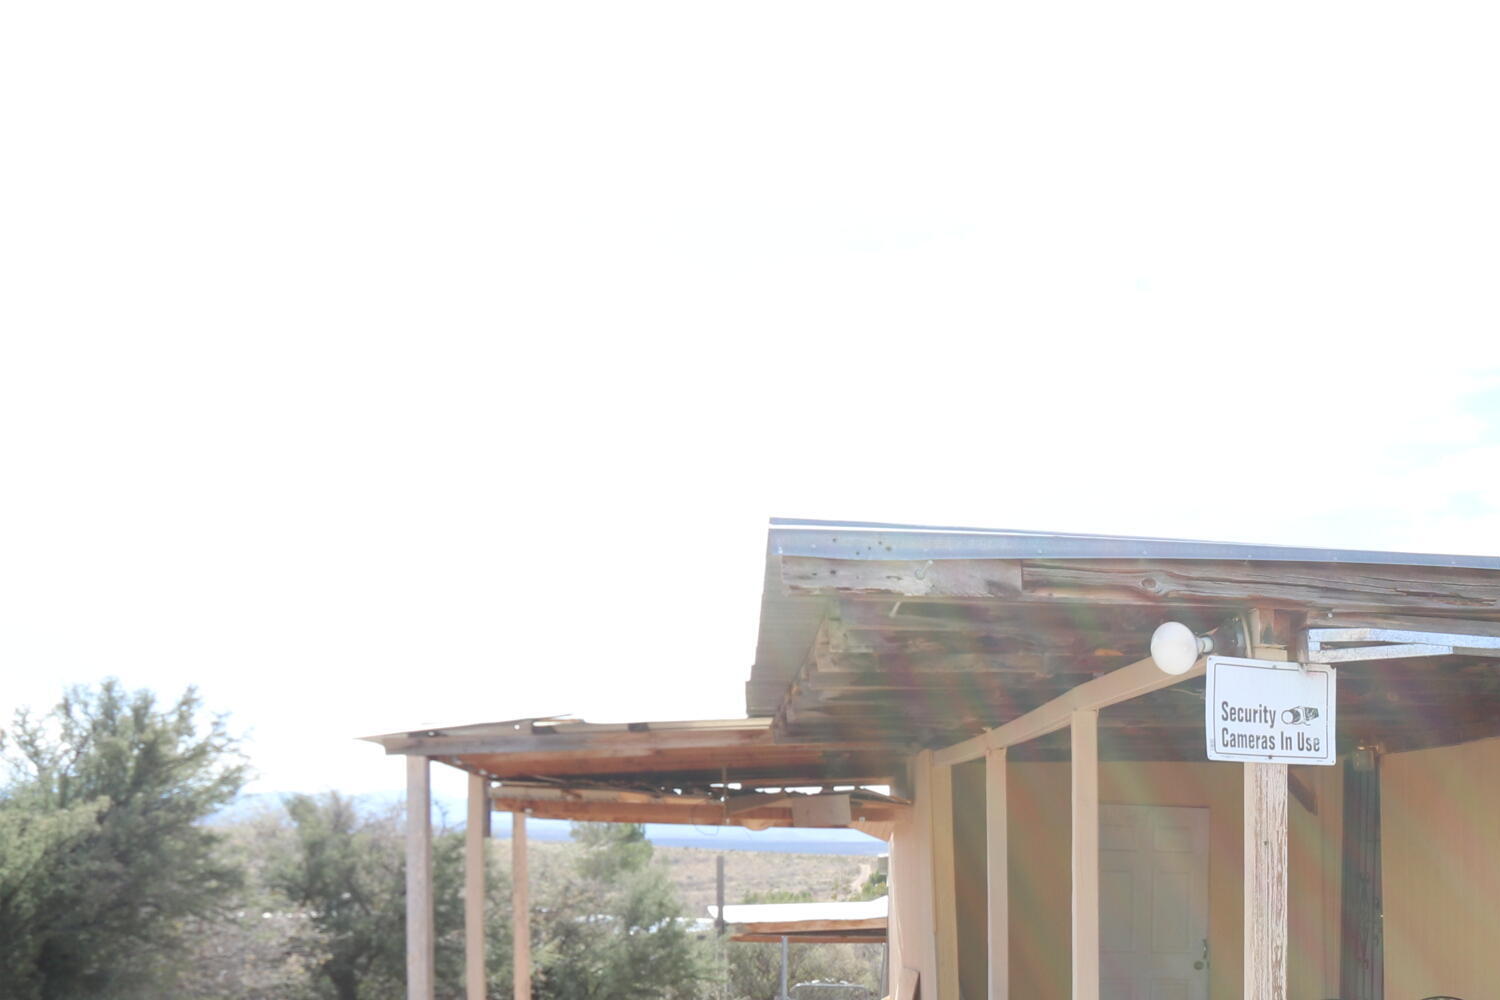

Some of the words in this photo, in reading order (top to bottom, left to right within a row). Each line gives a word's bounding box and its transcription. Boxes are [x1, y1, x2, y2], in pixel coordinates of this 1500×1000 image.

[1221, 700, 1276, 728] Security
[1221, 727, 1276, 750] Cameras
[1280, 731, 1292, 751] In
[1297, 732, 1320, 752] Use
